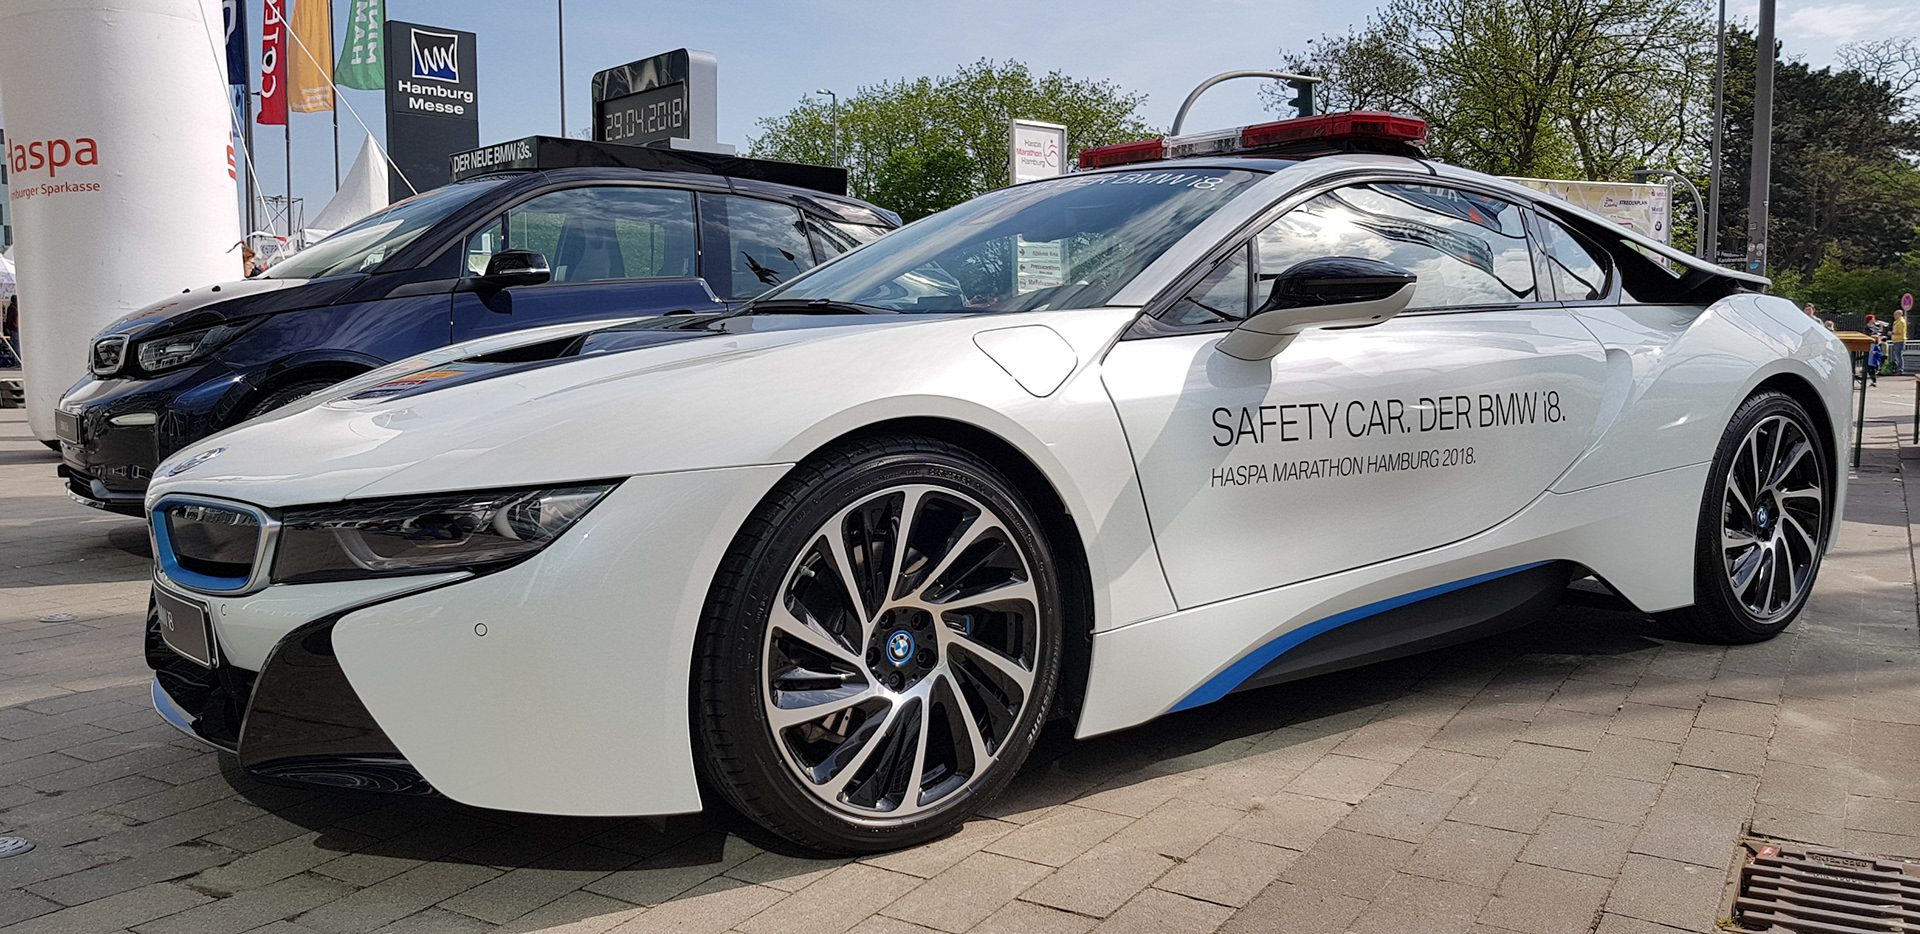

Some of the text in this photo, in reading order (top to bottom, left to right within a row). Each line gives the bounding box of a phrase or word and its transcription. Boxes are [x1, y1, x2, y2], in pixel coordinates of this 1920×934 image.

[398, 80, 474, 104] Hamburg
[408, 97, 465, 115] Messe
[605, 98, 682, 141] 29.04.2018
[453, 141, 532, 173] DER NEUE BMW i3s.
[1016, 147, 1042, 158] Marathon
[1021, 157, 1046, 168] Hamburg
[40, 181, 101, 197] Sparkasse
[1111, 172, 1188, 186] BMW
[1211, 390, 1566, 447] SAFETY CAR. DER BMW i8.
[1211, 447, 1477, 488] HASPA MARATHON HAMBURG 2018.
